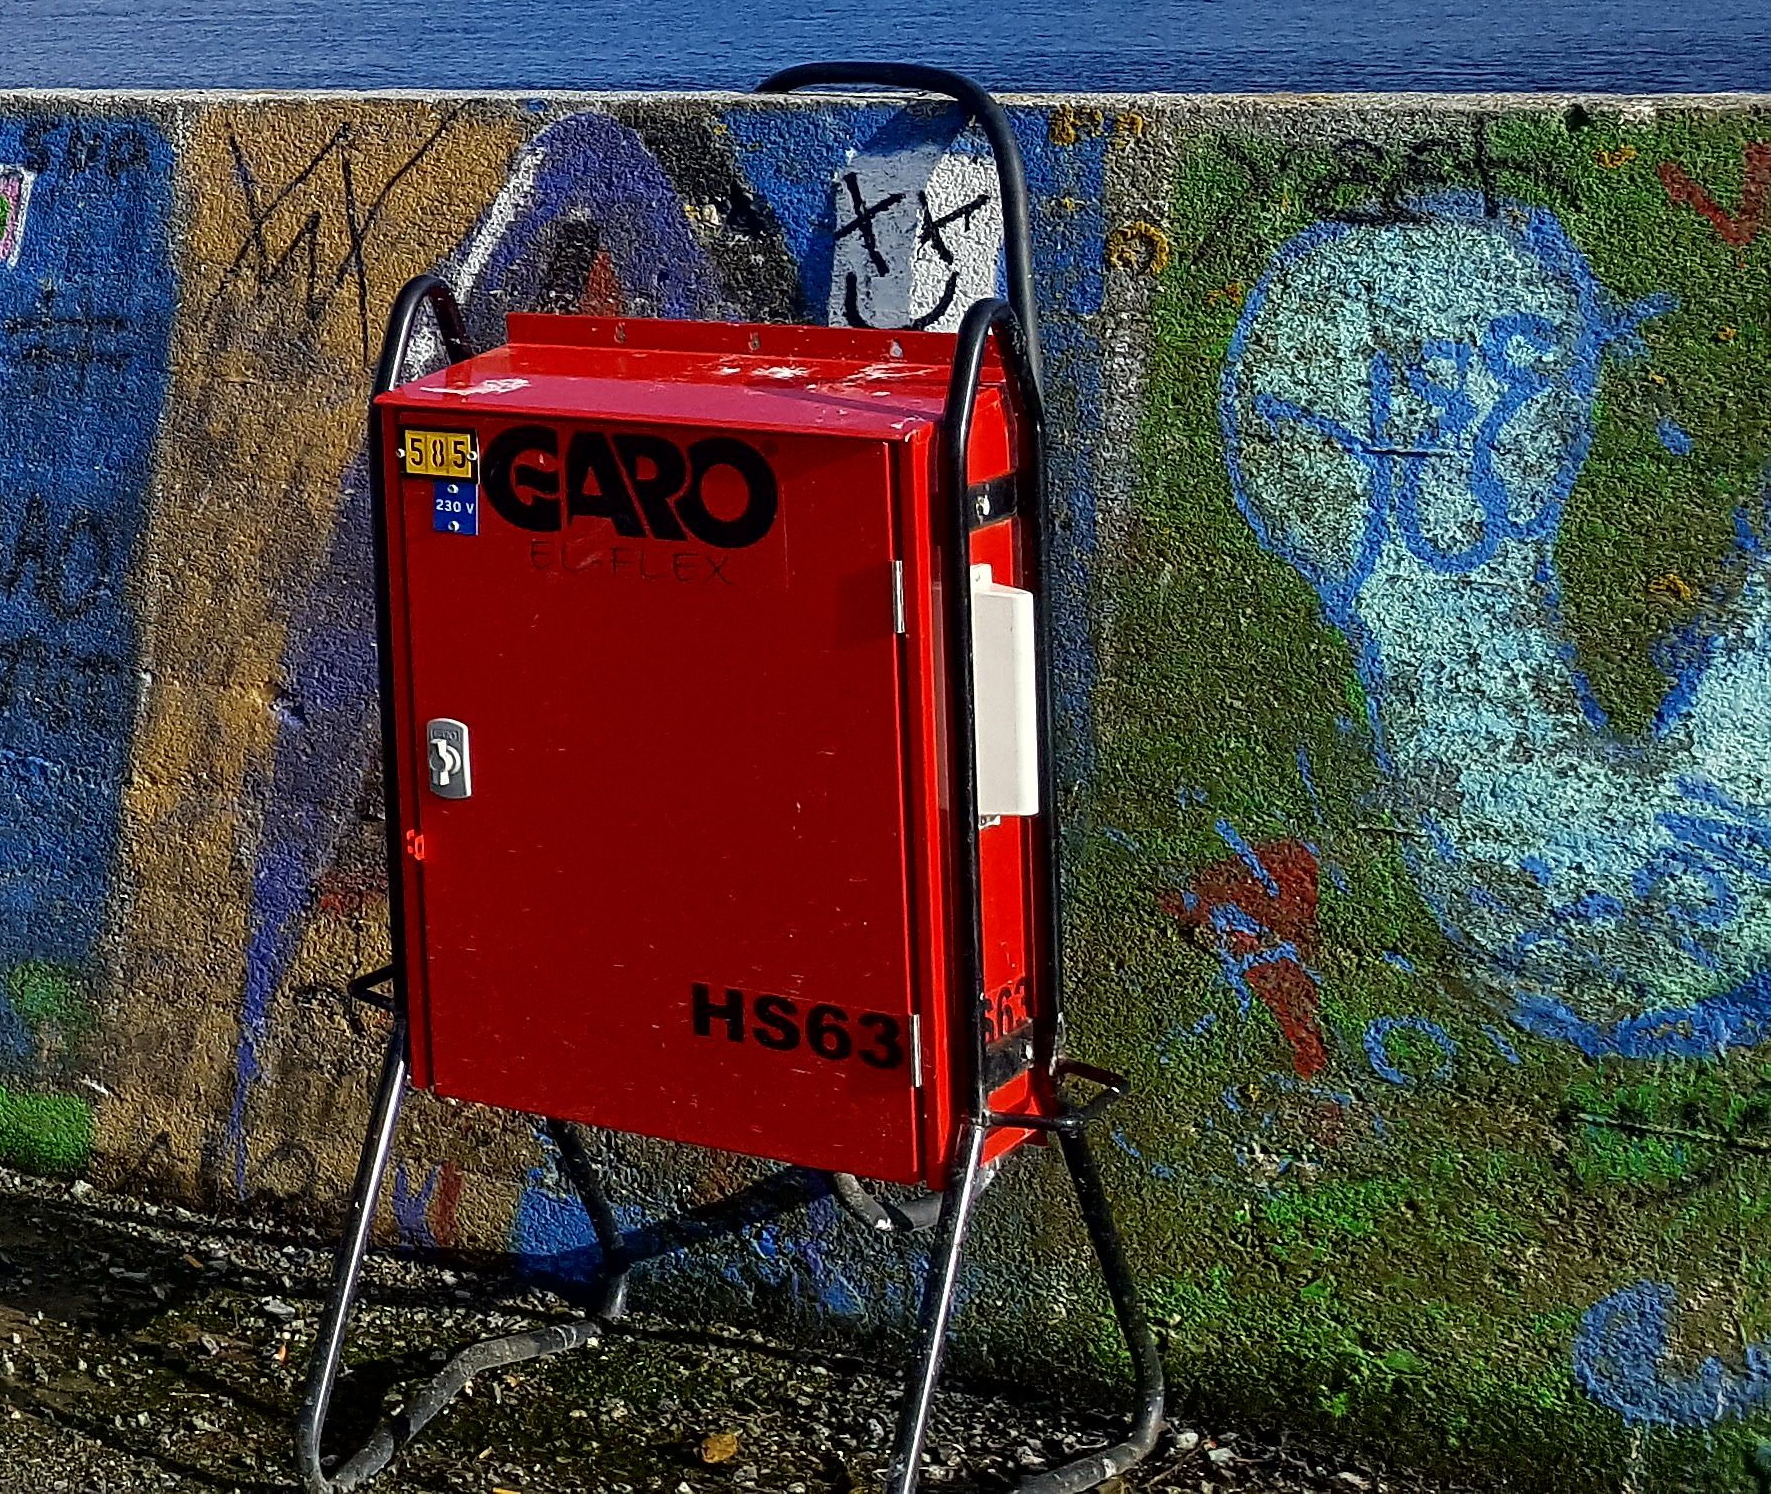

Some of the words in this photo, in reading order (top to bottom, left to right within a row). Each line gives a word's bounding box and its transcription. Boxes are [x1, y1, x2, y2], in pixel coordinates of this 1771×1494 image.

[410, 437, 467, 469] 585
[435, 499, 462, 513] 230
[466, 502, 475, 515] V
[482, 425, 779, 549] GARO
[692, 981, 905, 1069] HS63
